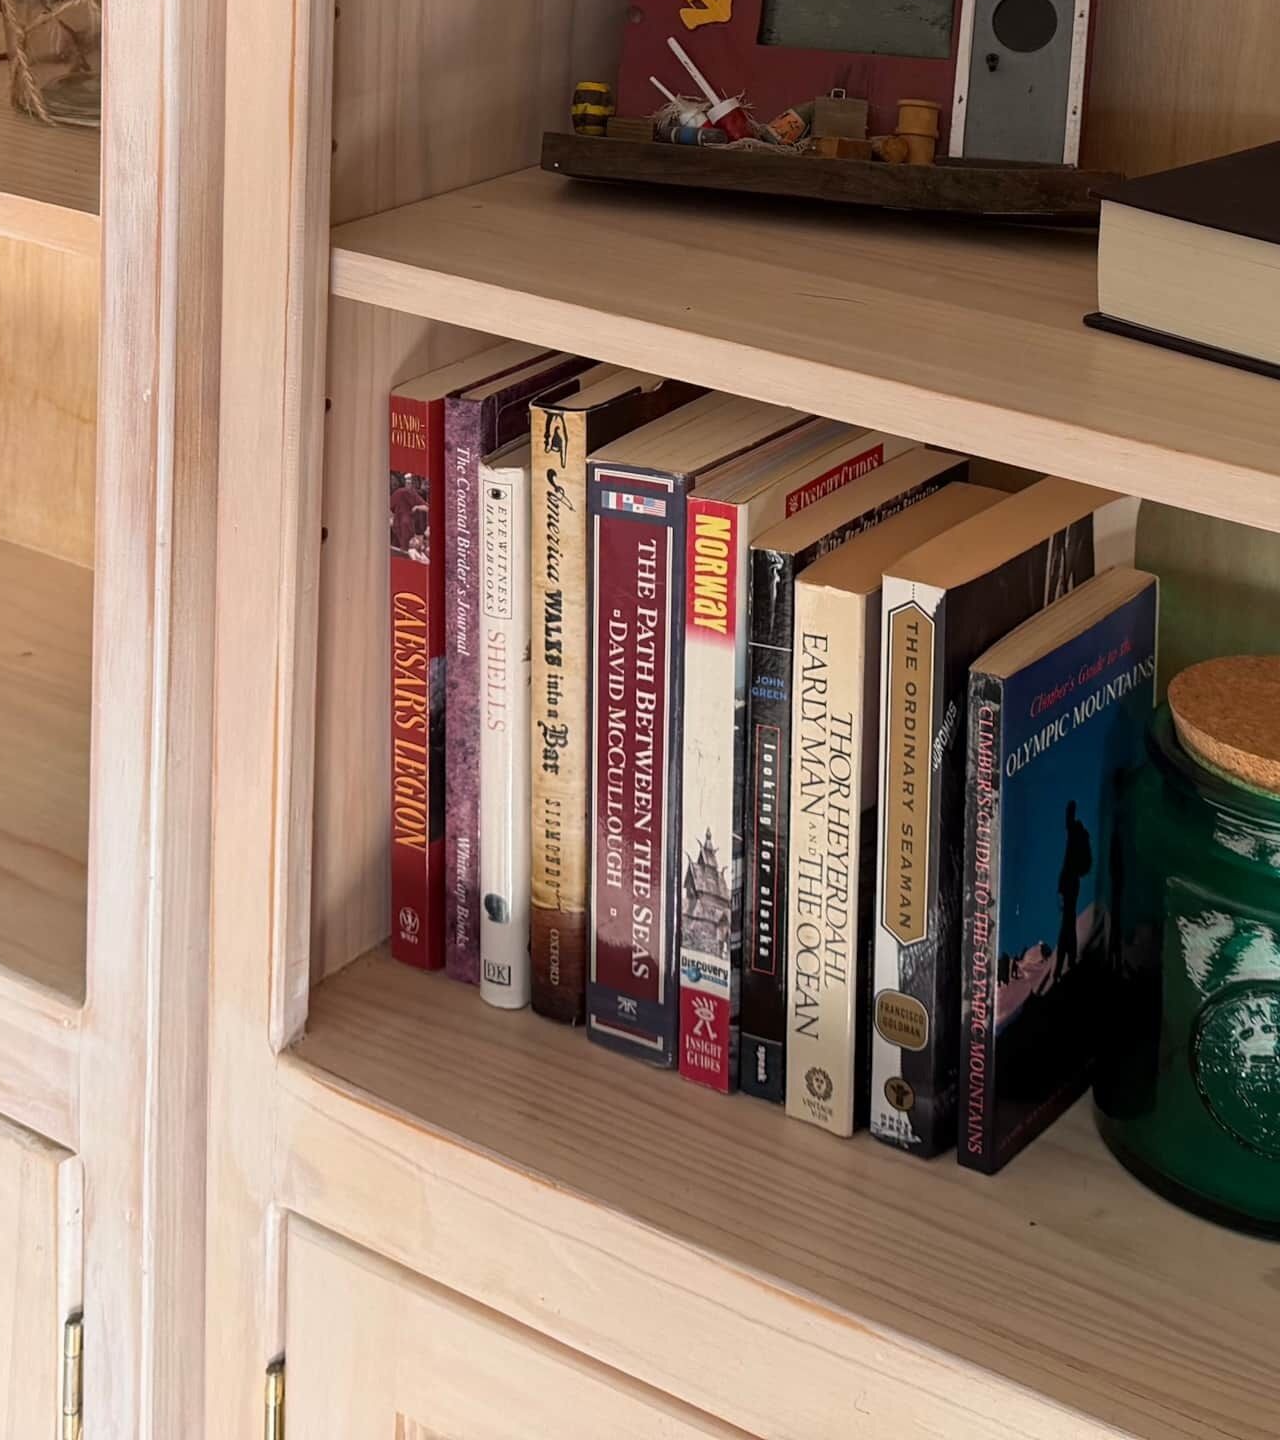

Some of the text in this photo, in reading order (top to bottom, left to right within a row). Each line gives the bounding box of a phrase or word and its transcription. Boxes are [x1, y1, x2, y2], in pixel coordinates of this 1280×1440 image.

[391, 412, 425, 433] DANDO-
[391, 430, 426, 450] COLLINS
[456, 447, 471, 656] The Coastal Birder's Journal
[485, 503, 495, 611] HANDBOOKS
[497, 505, 508, 614] EYEWITNESS
[537, 468, 577, 776] America WALKS into a Bar
[607, 619, 627, 700] DAVID
[487, 628, 507, 733] SHELLS
[751, 686, 788, 701] GREEN
[755, 675, 785, 688] JOHN
[1006, 713, 1070, 777] OLYMPIC
[1071, 655, 1155, 729] MOUNTAINS
[1030, 676, 1075, 718] Climber's
[393, 737, 428, 852] LEGION
[630, 538, 658, 979] THE PATH BETWEEN THE SEAS
[898, 621, 919, 929] THE ORDINARY SEAMAN
[544, 798, 561, 890] SISMONDO
[758, 743, 777, 958] looking for alaska
[794, 630, 827, 1041] EARLY MAN AND THE OCEAN
[824, 711, 853, 988] THOR HEYERDAHL
[454, 906, 471, 948] Books
[487, 961, 507, 982] DK
[549, 928, 561, 986] OXFORD
[966, 706, 995, 1155] CLIMBER'S GUIDE TO THE OLYMPIC MOUNTAINS
[685, 1033, 722, 1059] INSIGHT
[880, 1000, 925, 1025] FRANCISCO
[882, 1015, 921, 1037] GOLDMAN
[686, 1049, 722, 1073] GUIDES
